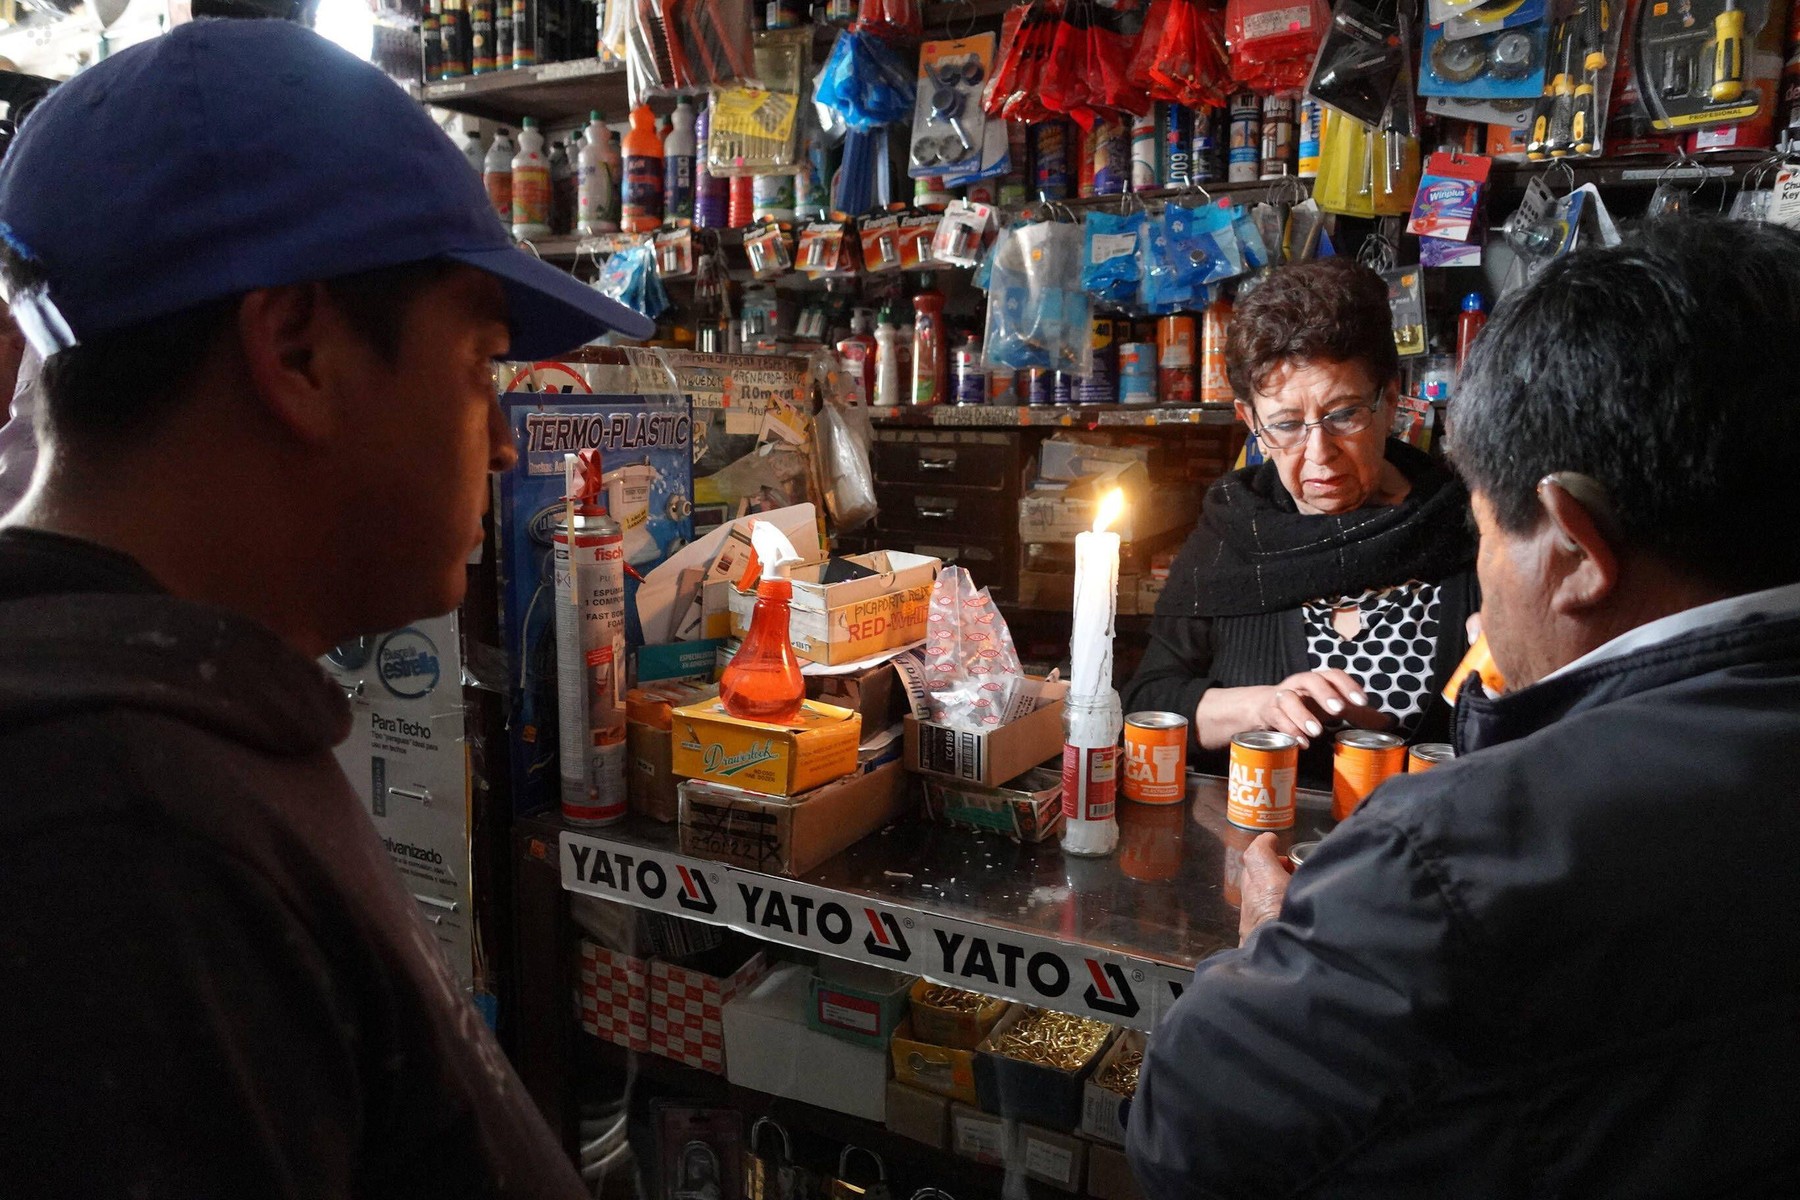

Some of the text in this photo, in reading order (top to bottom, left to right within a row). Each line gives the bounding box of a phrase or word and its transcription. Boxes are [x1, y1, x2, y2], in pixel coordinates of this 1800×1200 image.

[1782, 191, 1800, 201] Key
[527, 413, 691, 452] TERMO-PLASTIC
[586, 611, 609, 621] FAST
[847, 605, 930, 643] RED-WHIT
[372, 713, 431, 739] Para Techo
[945, 731, 956, 762] TC4189
[382, 837, 443, 865] alvanizado
[568, 843, 667, 899] YATO
[737, 883, 853, 945] YATO
[933, 928, 1070, 998] YATO
